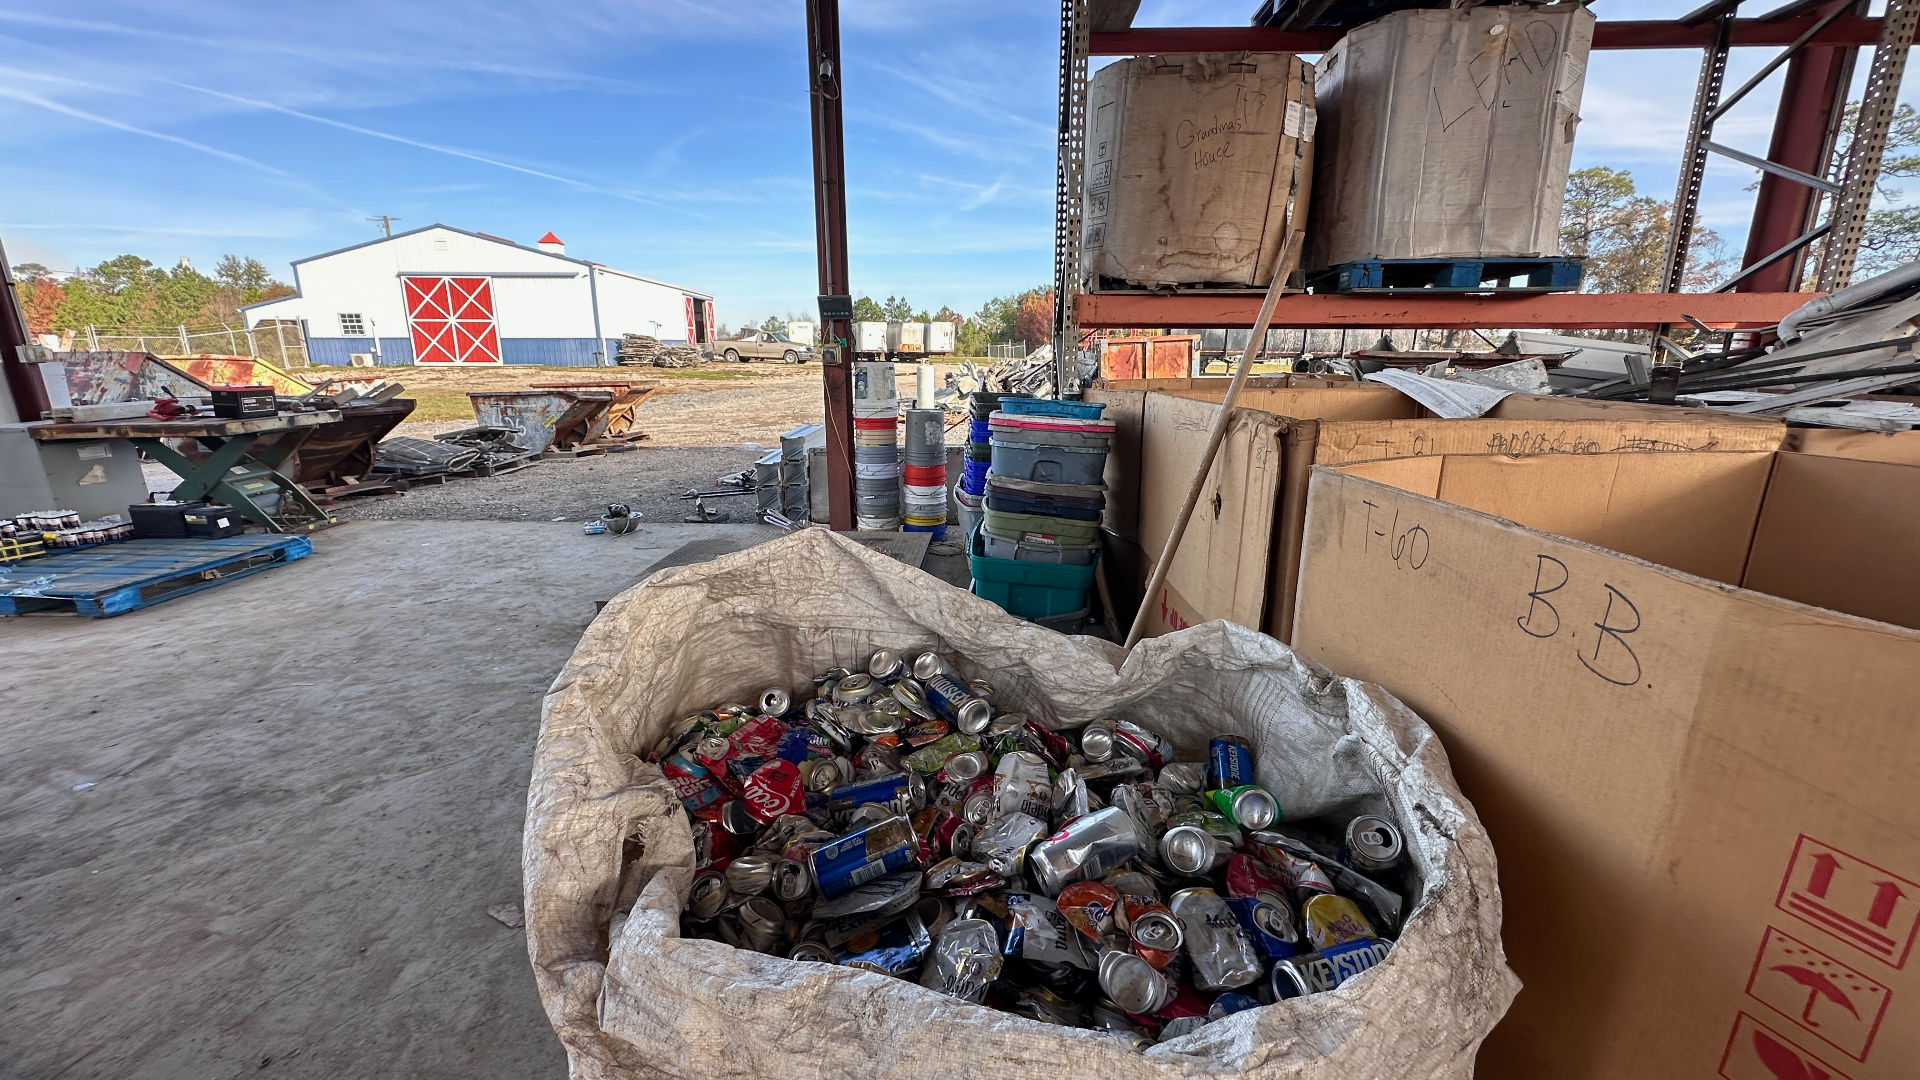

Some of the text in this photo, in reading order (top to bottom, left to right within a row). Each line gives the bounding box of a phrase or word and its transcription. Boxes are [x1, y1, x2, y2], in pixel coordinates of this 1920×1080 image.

[1433, 20, 1557, 132] LEAD
[1194, 142, 1235, 170] House
[1362, 499, 1430, 570] T-60
[929, 675, 972, 709] KEYSTON
[1227, 744, 1240, 780] KEYSTONE
[1021, 799, 1050, 818] odelo
[1300, 943, 1392, 993] KEYSTON
